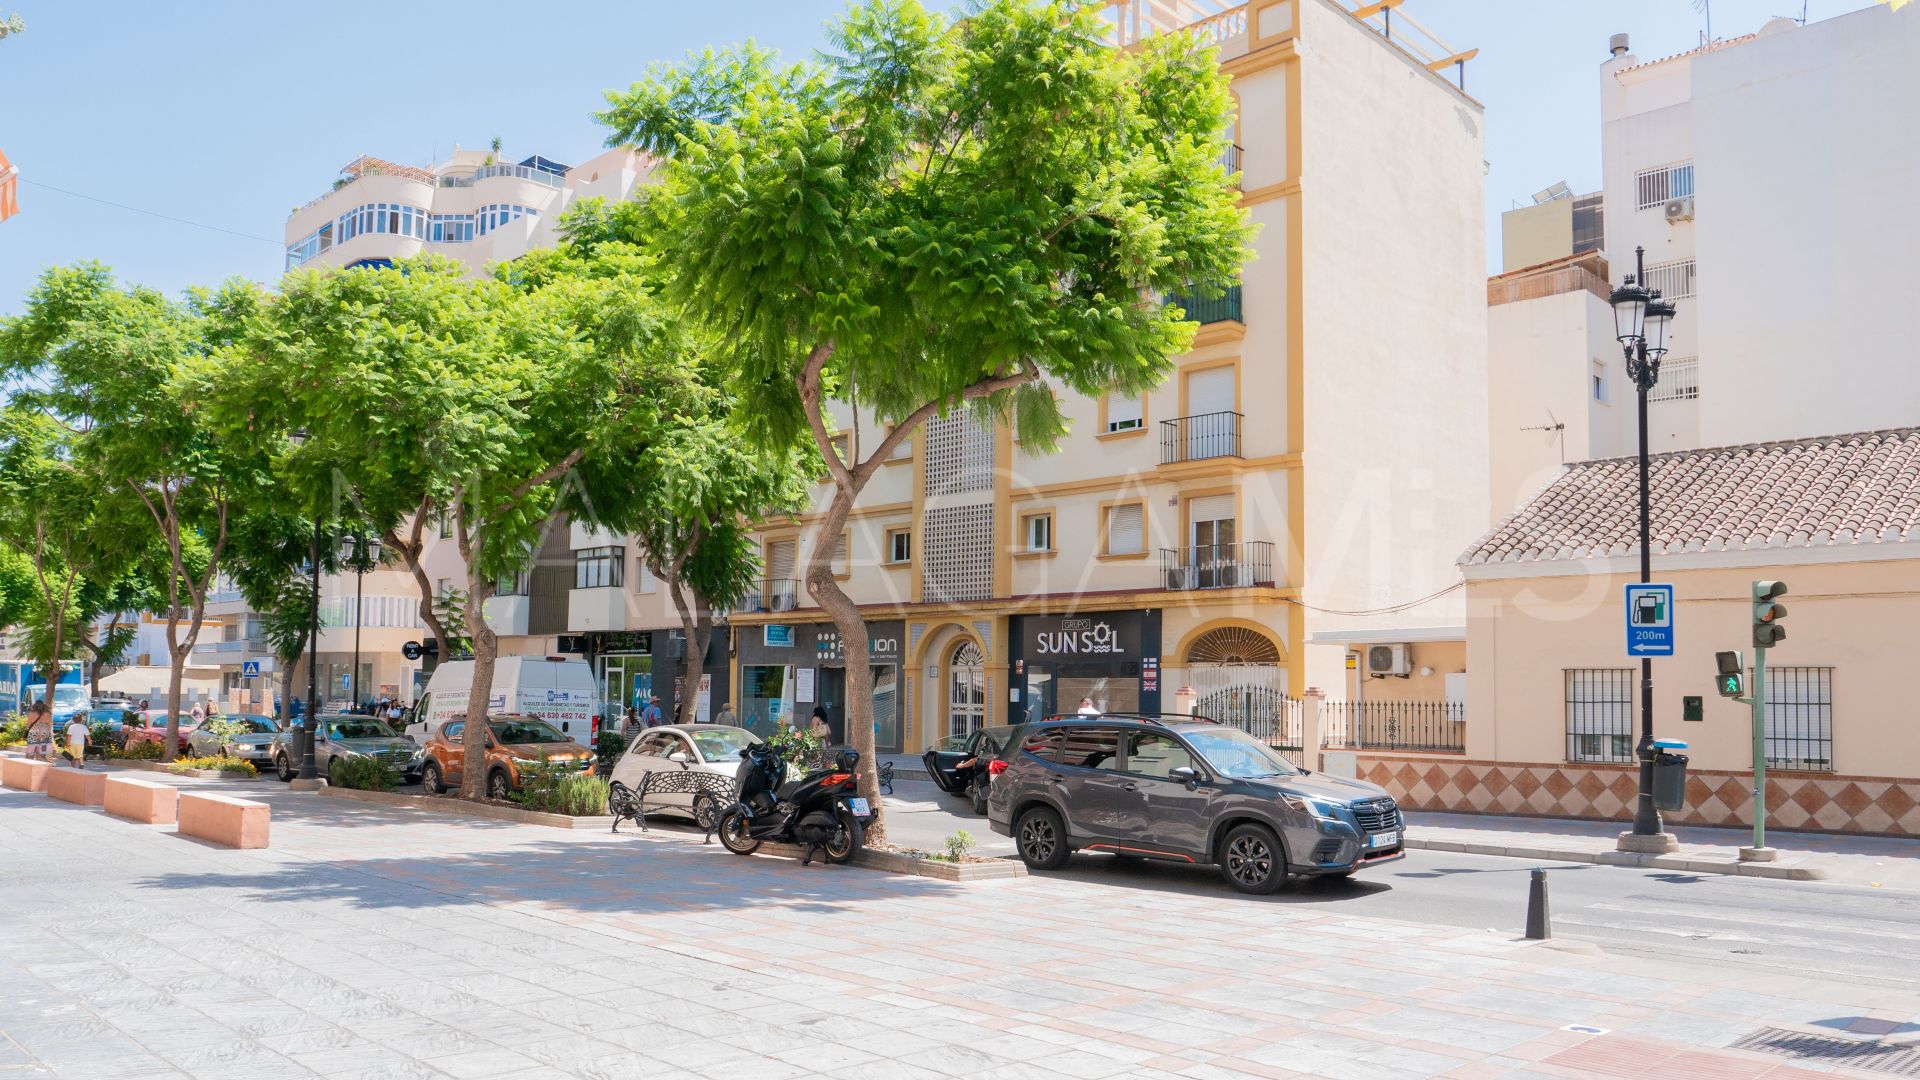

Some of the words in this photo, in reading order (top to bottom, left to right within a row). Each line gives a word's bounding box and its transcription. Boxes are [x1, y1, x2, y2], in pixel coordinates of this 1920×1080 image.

[1064, 621, 1088, 629] GRUPO
[1037, 631, 1078, 654] SUN
[1081, 622, 1125, 653] SOL
[1636, 630, 1665, 640] 200m
